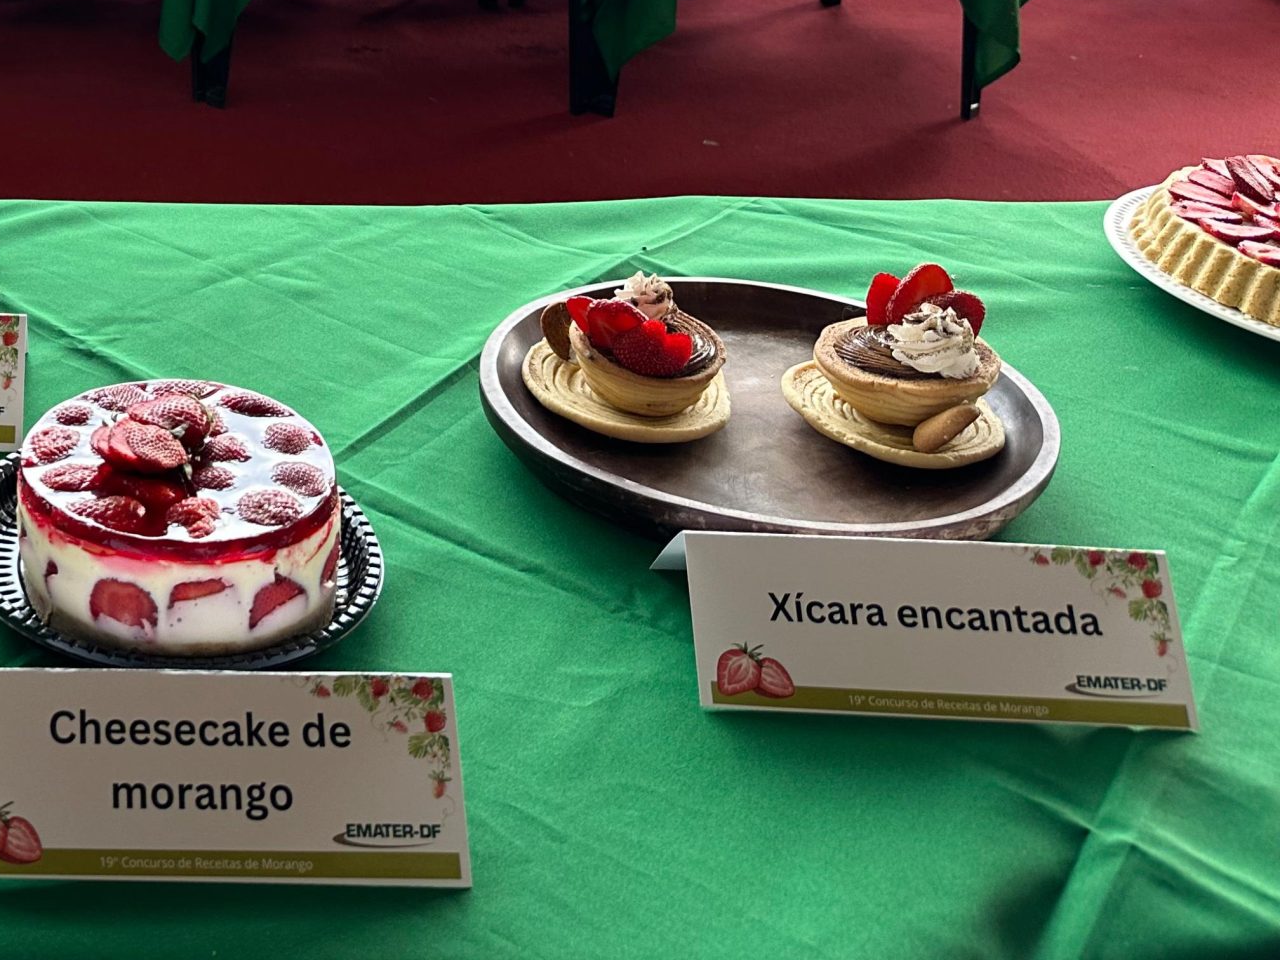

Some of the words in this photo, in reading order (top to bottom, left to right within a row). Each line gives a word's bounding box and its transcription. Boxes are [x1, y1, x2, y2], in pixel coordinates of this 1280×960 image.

[768, 591, 888, 627] Xícara
[897, 602, 1104, 637] encantada
[1076, 674, 1168, 692] EMATER-DF
[868, 695, 919, 709] Concurso
[920, 697, 935, 709] de
[937, 699, 981, 712] Receitas
[983, 701, 998, 713] de
[1000, 702, 1049, 717] Morango
[50, 709, 290, 747] Cheesecake
[303, 713, 352, 748] de
[112, 782, 294, 822] morango
[345, 823, 441, 839] EMATER-DF
[121, 856, 176, 869] Concurso
[178, 856, 192, 869] de
[195, 857, 241, 870] Receitas
[244, 857, 259, 870] de
[262, 858, 314, 873] Morango
